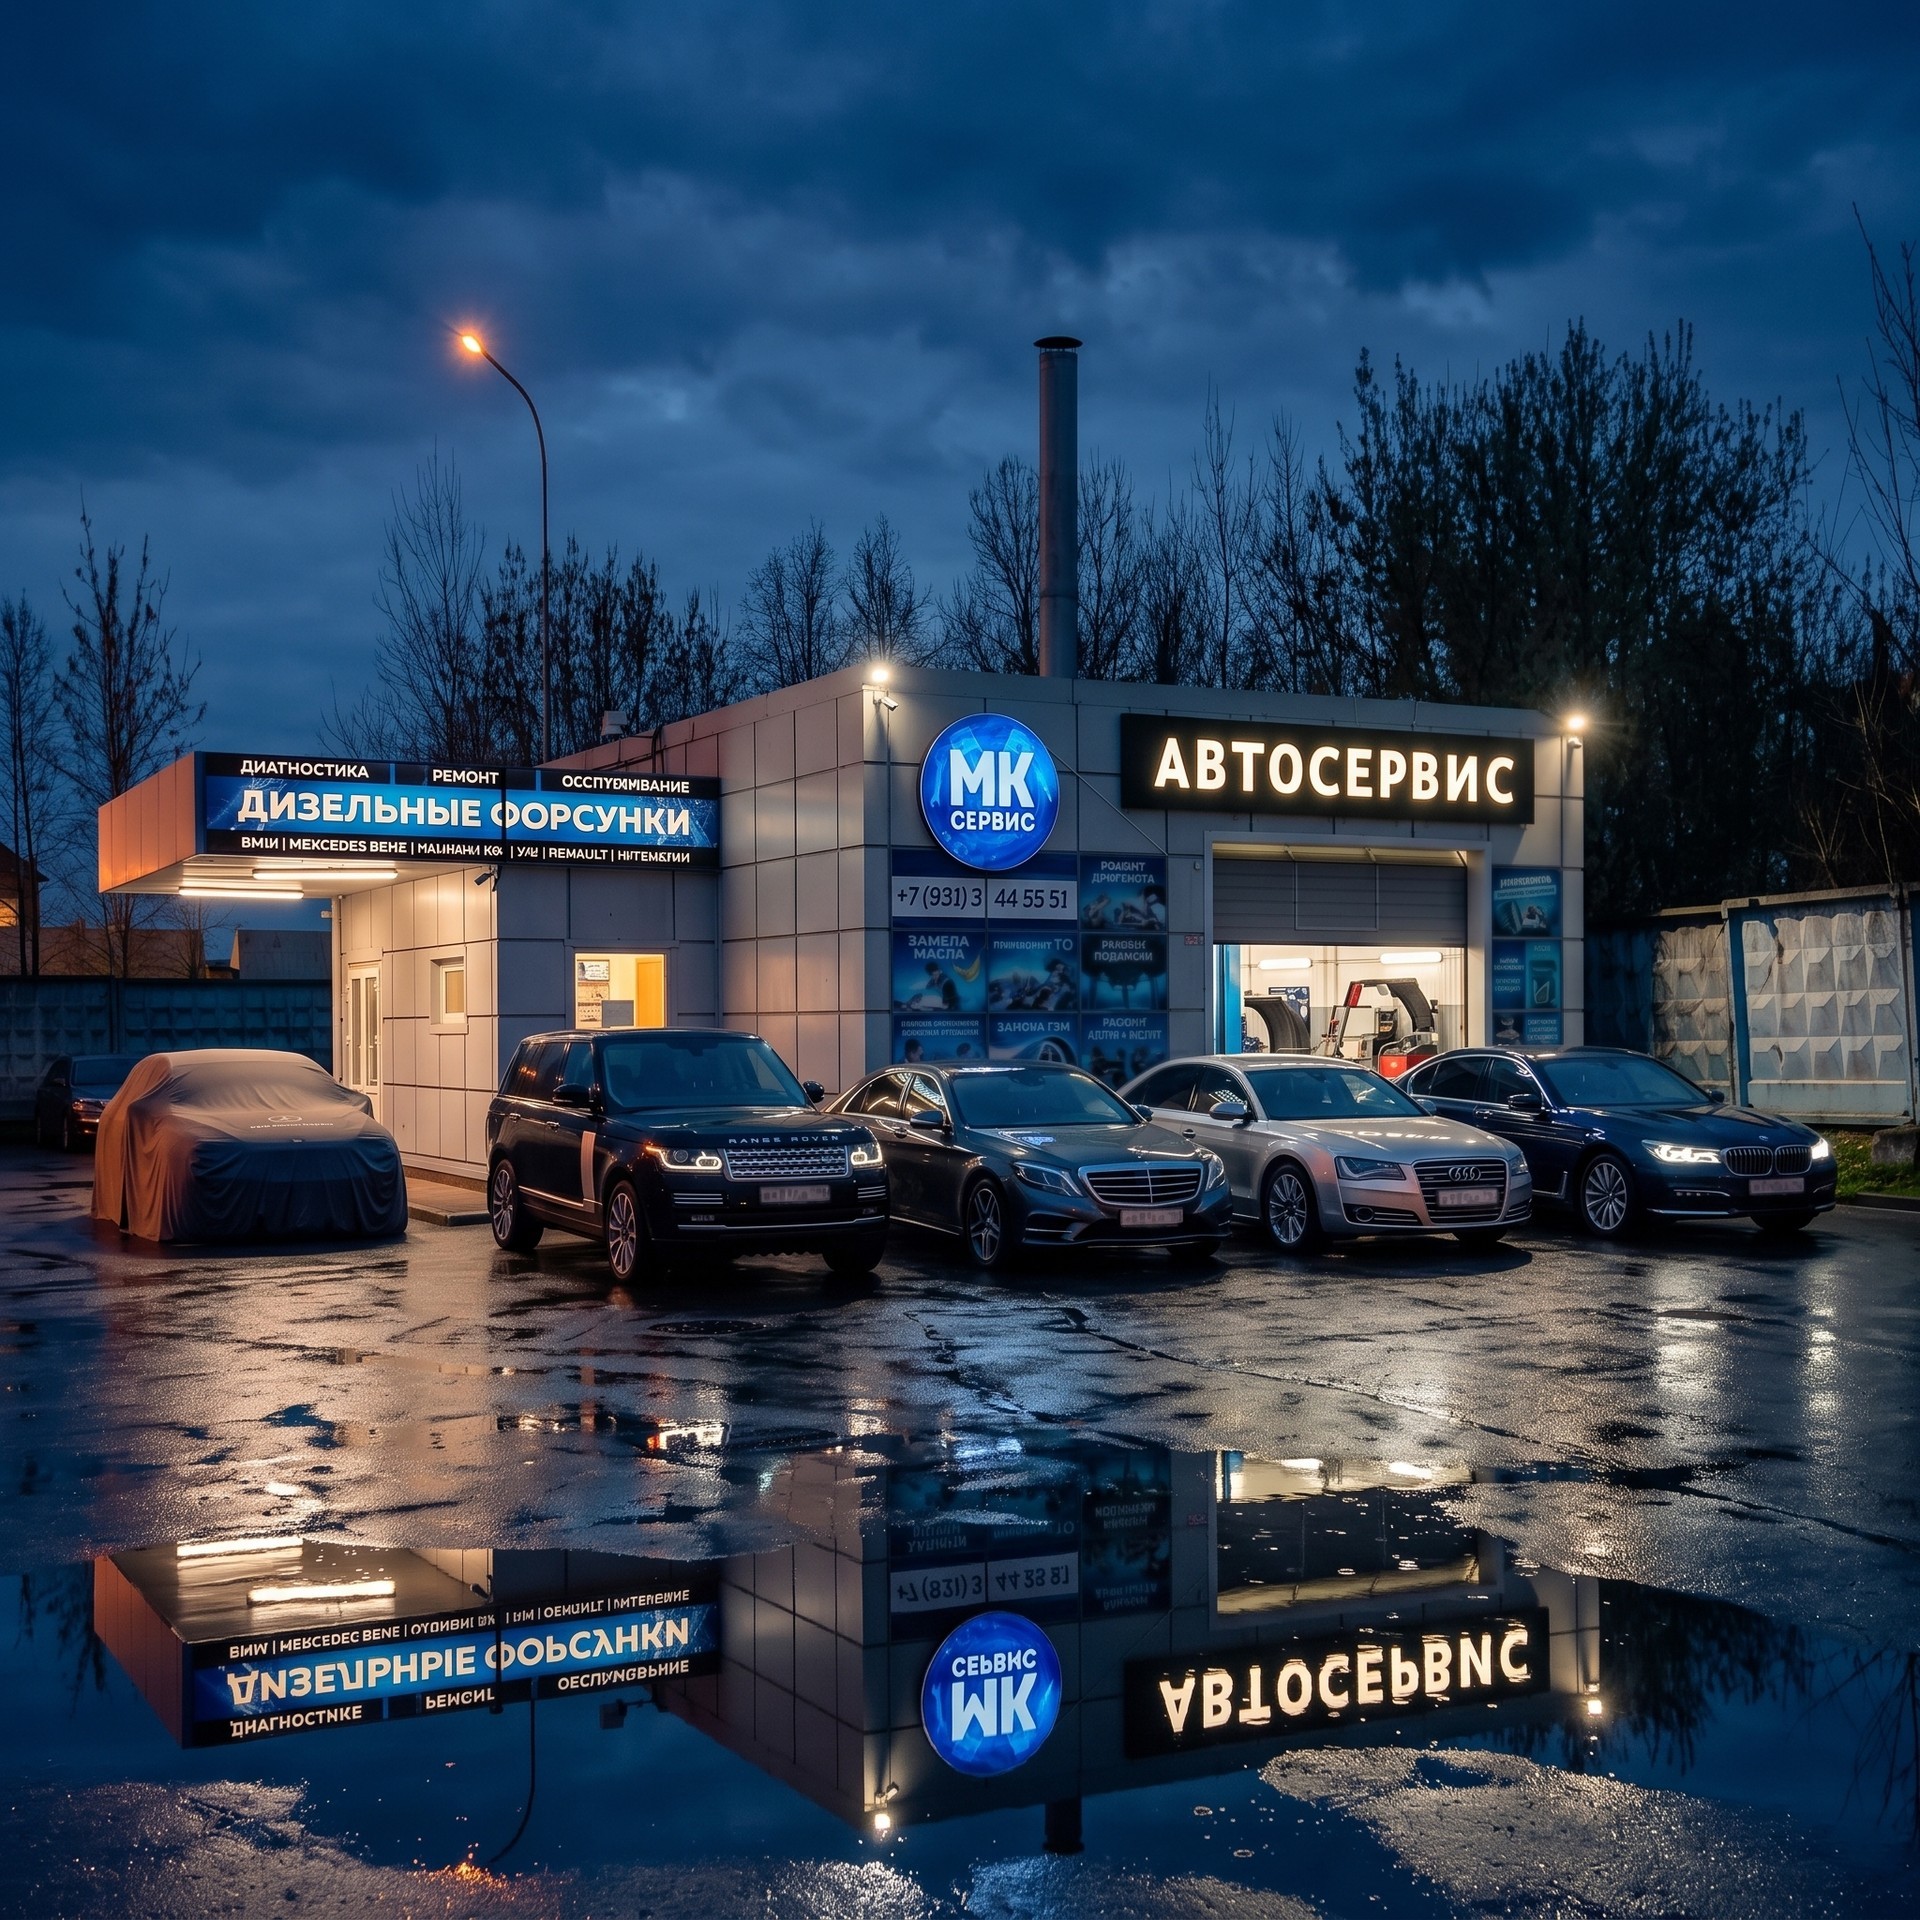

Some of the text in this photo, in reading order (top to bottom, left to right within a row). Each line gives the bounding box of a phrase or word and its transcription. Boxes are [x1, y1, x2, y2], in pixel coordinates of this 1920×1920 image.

[240, 759, 370, 779] ДИАГНОСТИКА
[432, 768, 500, 786] РЕМОНТ
[948, 749, 1035, 809] МК
[1153, 736, 1516, 805] АВТОСЕРВИС
[237, 789, 690, 836] ДИЗЕЛЬНЫЕ ФОРСУНКИ
[950, 808, 1036, 833] СЕРВИС
[994, 889, 1018, 908] 44
[1022, 890, 1045, 909] 55
[1049, 890, 1068, 910] 51
[1054, 938, 1074, 952] ТО
